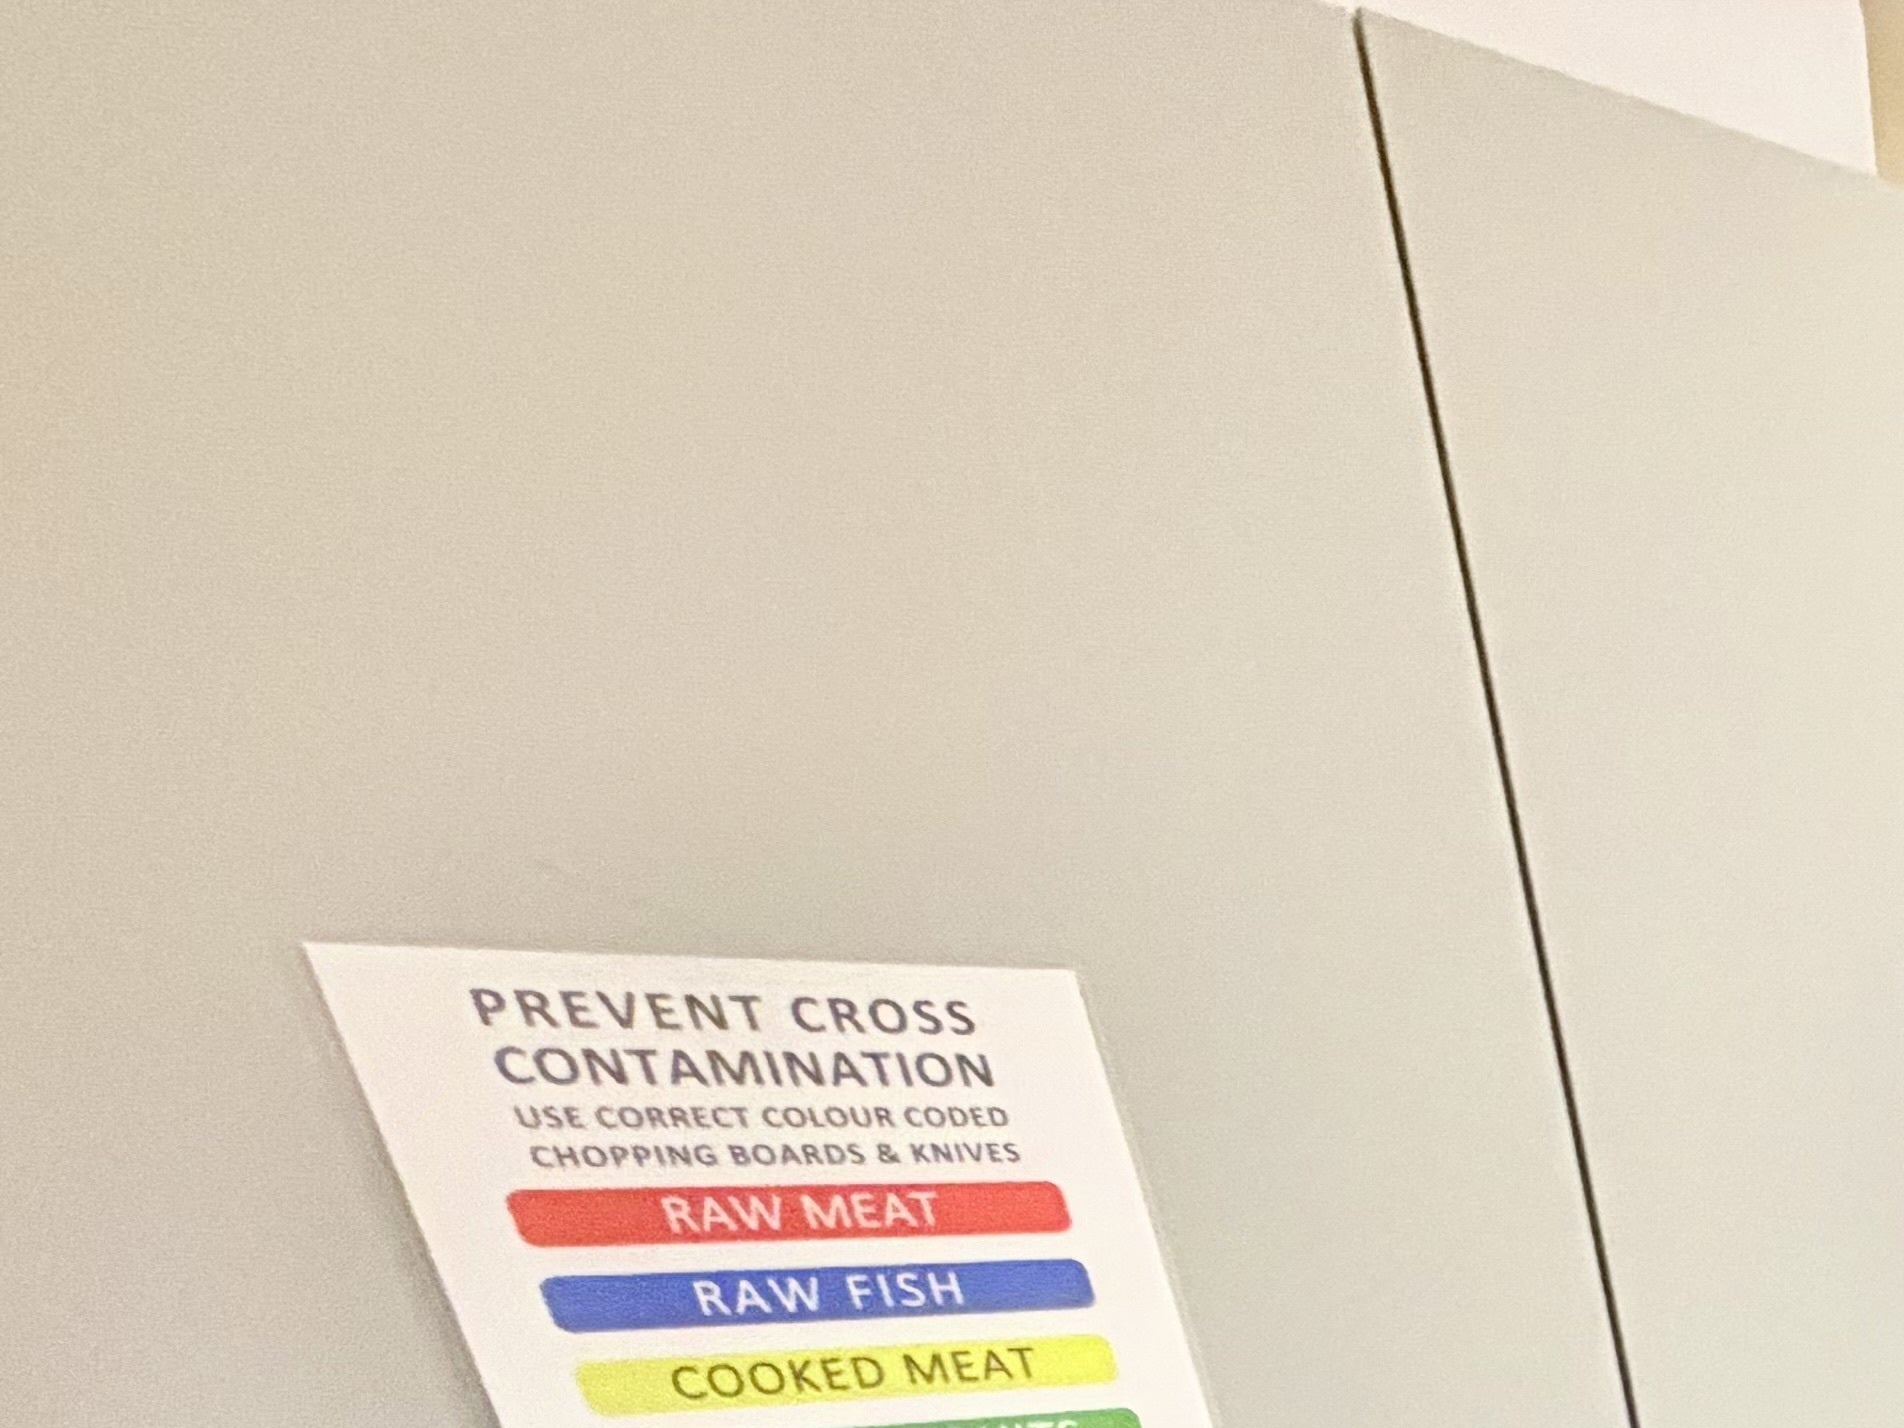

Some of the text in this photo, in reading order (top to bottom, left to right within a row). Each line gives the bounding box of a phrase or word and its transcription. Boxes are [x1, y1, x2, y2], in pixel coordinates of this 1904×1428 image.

[469, 986, 977, 1036] PREVENT CROSS
[494, 1044, 996, 1088] CONTAMINATION
[514, 1105, 1010, 1130] USE CORRECT COLOUR CODED
[530, 1140, 1021, 1169] CHOPPING BOARDS & KNIVES
[660, 1190, 938, 1234] RAW MEAT
[691, 1271, 966, 1317] RAW FISH
[671, 1347, 1035, 1400] COOKED MEAT
